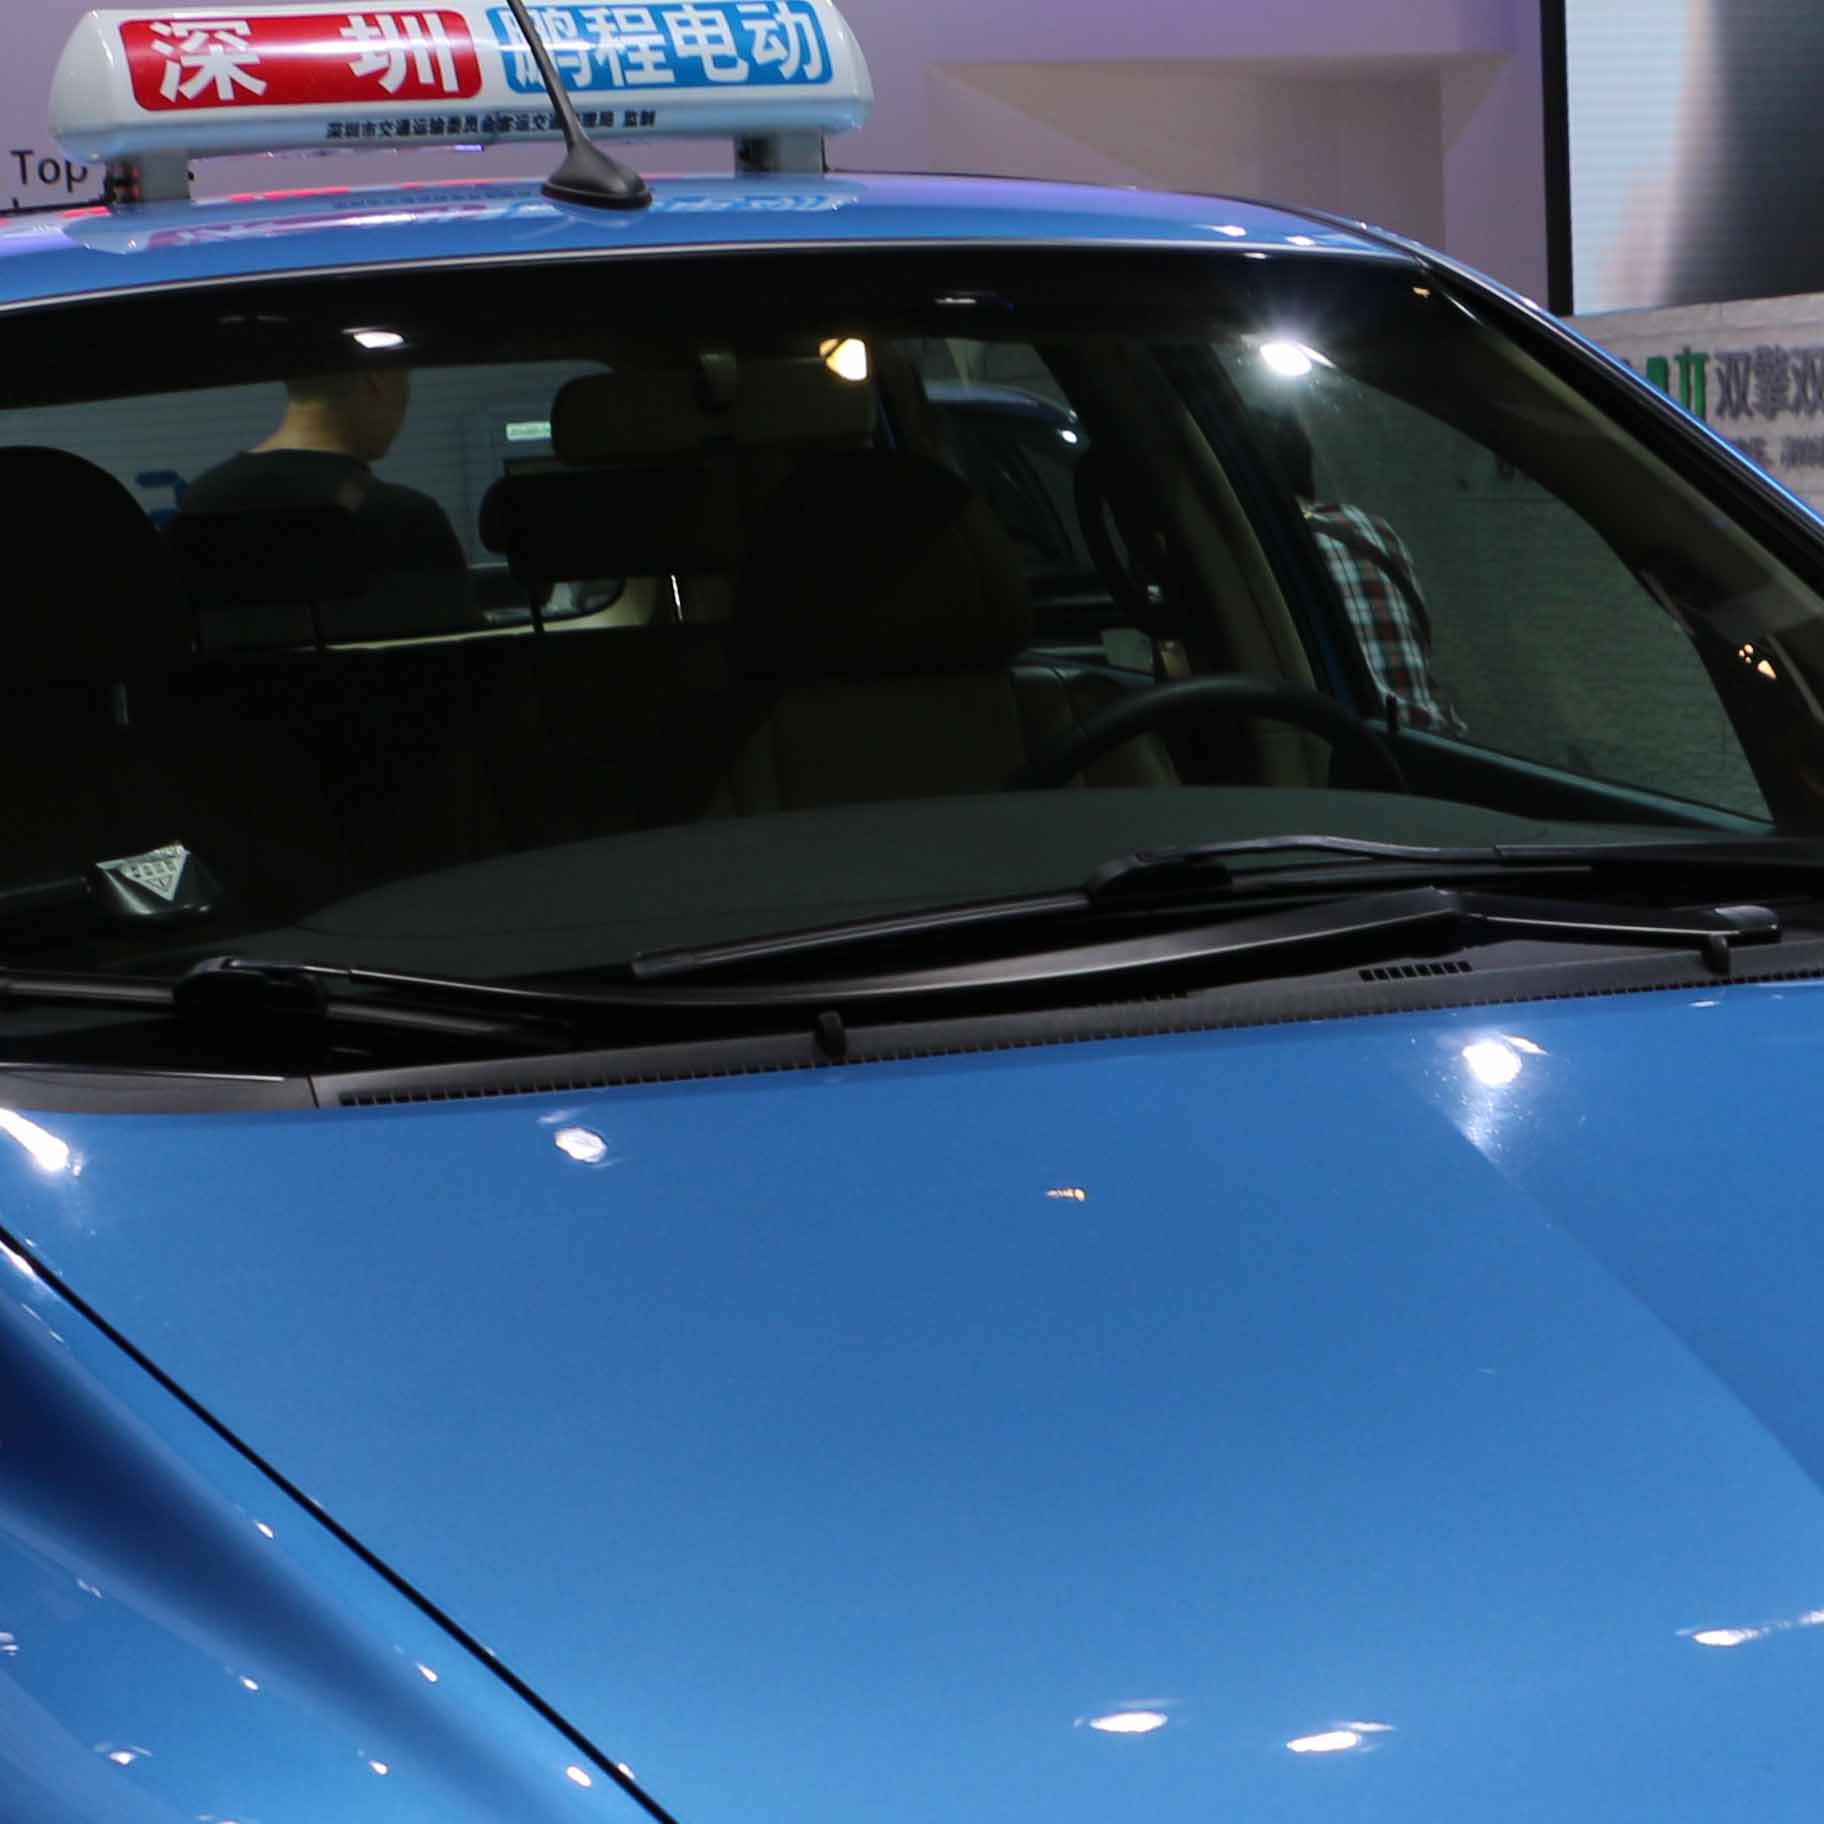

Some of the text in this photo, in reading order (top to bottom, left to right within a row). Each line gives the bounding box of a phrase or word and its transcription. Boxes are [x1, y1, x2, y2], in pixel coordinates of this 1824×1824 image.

[152, 1, 823, 100] 深圳 鹏程电动
[10, 150, 88, 193] Top
